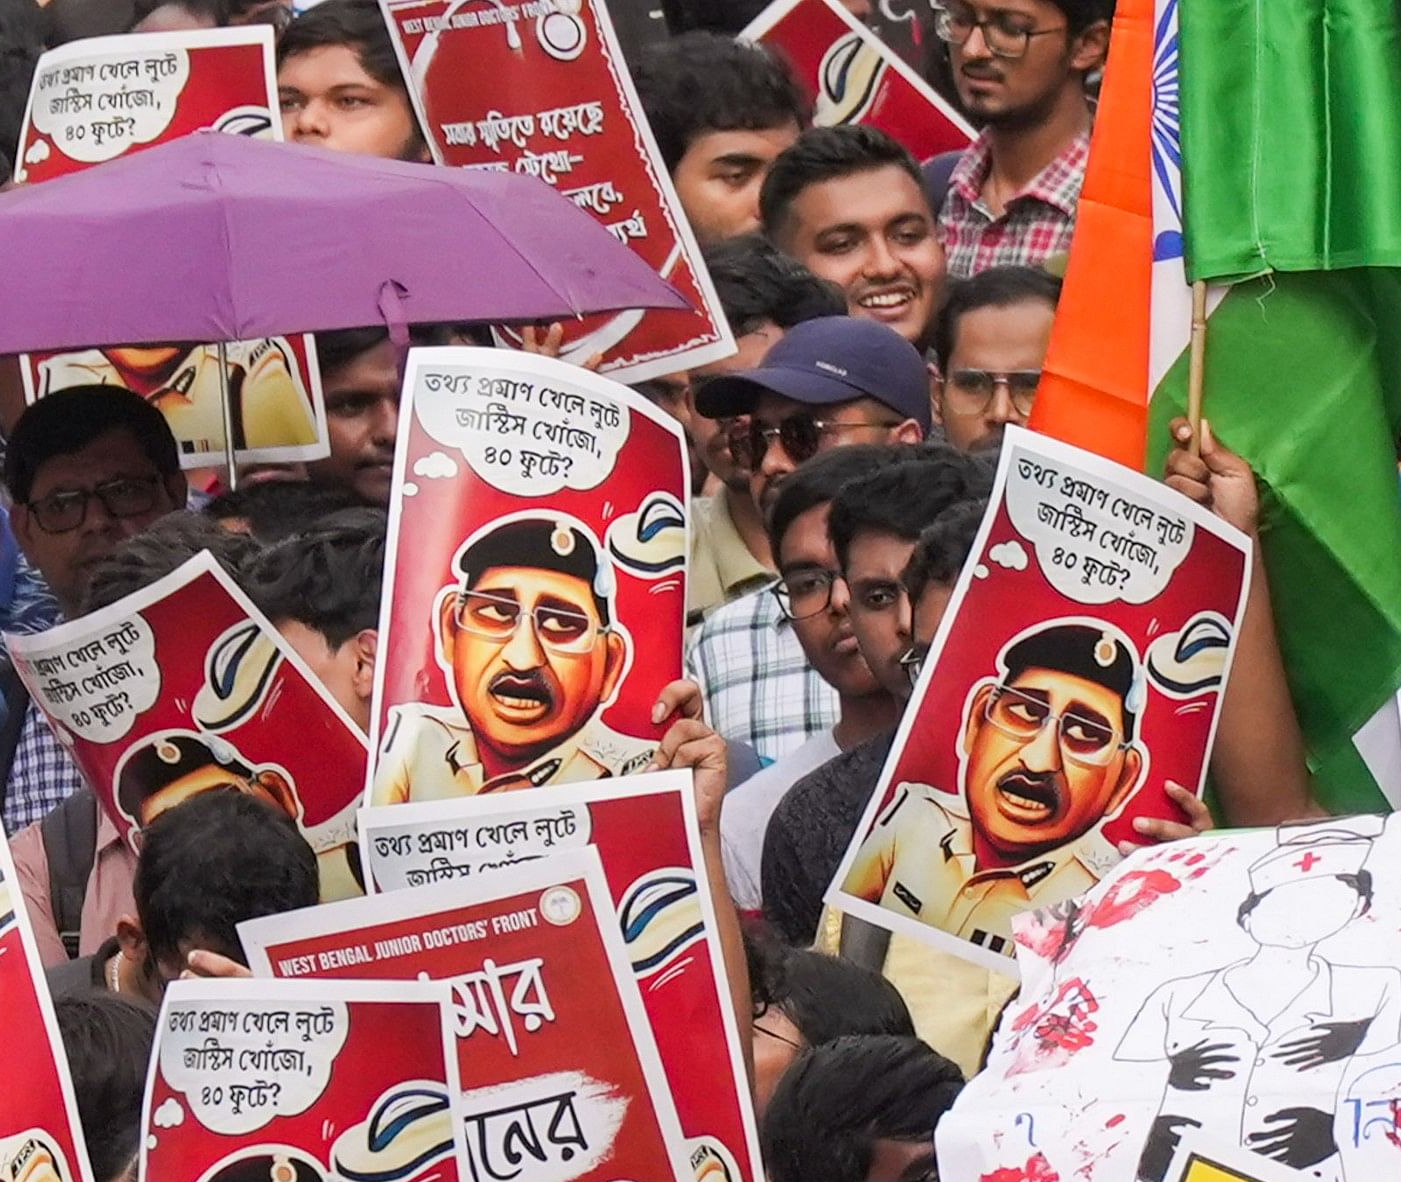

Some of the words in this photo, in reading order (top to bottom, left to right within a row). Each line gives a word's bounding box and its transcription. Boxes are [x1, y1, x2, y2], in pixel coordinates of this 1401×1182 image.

[424, 374, 473, 396] তথ্য
[477, 375, 533, 404] প্রমাণ
[539, 386, 586, 417] খেলে
[590, 401, 621, 431] লুটে
[456, 401, 527, 436] জাস্টিস
[531, 418, 602, 459] খোঁজো,
[484, 446, 512, 467] ৪০
[519, 448, 574, 480] ফুটে?
[1018, 457, 1059, 488] তথ্য
[1059, 476, 1108, 511] প্রমাণ
[1110, 496, 1155, 530] খেলে
[1156, 515, 1185, 548] লুটে
[1036, 501, 1098, 542] জাস্টিস
[1099, 530, 1159, 576] খোঁজো,
[1050, 546, 1077, 570] ৪০
[1080, 555, 1131, 591] ফুটে?
[374, 832, 413, 857] তথ্য
[418, 829, 468, 853] প্রমাণ
[475, 821, 528, 848] খেলে
[533, 810, 577, 845] লুটে
[279, 957, 317, 979] WEST
[319, 945, 374, 974] BENGAL
[375, 937, 421, 961] JUNIOR
[422, 920, 491, 954] DOCTORS'
[492, 908, 539, 937] FRONT
[169, 1011, 197, 1033] তথ্য
[199, 1010, 240, 1033] প্রমাণ
[242, 1010, 289, 1034] খেলে
[295, 1005, 335, 1043] লুটে
[182, 1037, 234, 1071] জাস্টিস
[238, 1039, 312, 1077] খোঁজো,
[200, 1085, 223, 1106] ৪০
[228, 1080, 281, 1115] ফুটে?
